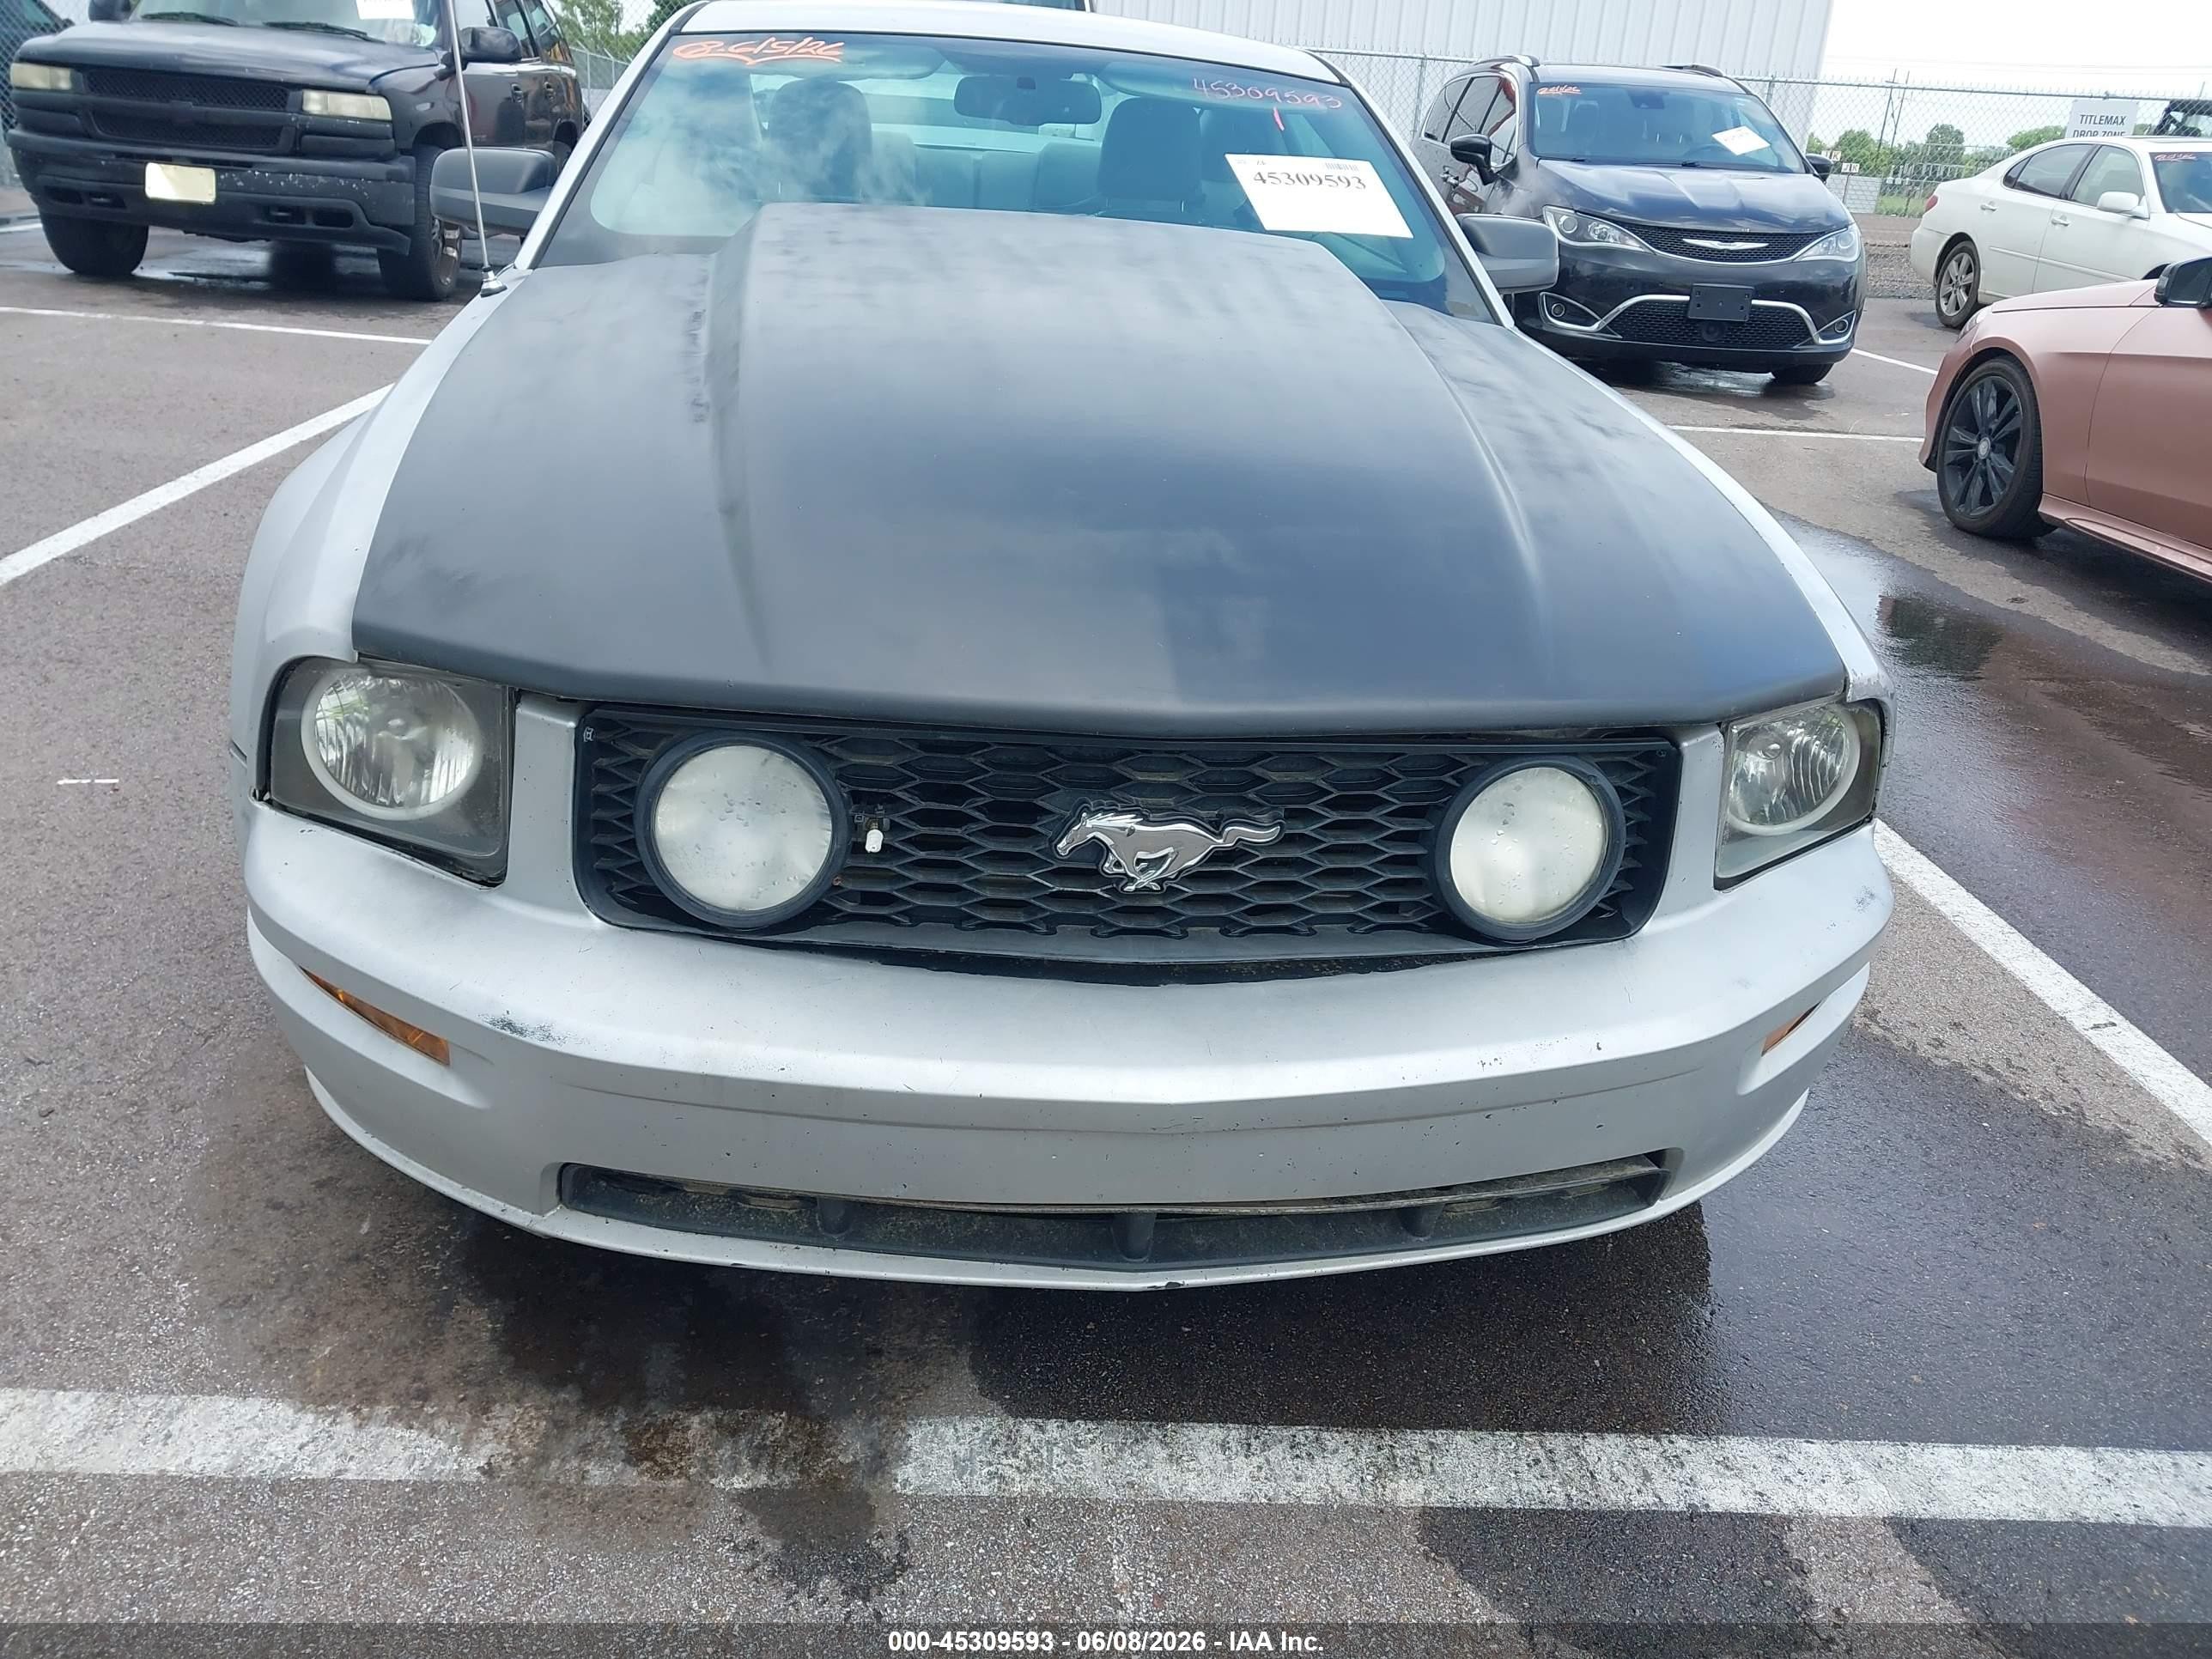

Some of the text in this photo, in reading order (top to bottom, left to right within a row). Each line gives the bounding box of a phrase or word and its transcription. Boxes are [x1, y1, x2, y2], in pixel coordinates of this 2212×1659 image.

[1193, 77, 1342, 109] 45309593
[2080, 114, 2127, 125] TITLEMAX
[2072, 129, 2099, 137] DROP
[1253, 171, 1366, 190] 45309593
